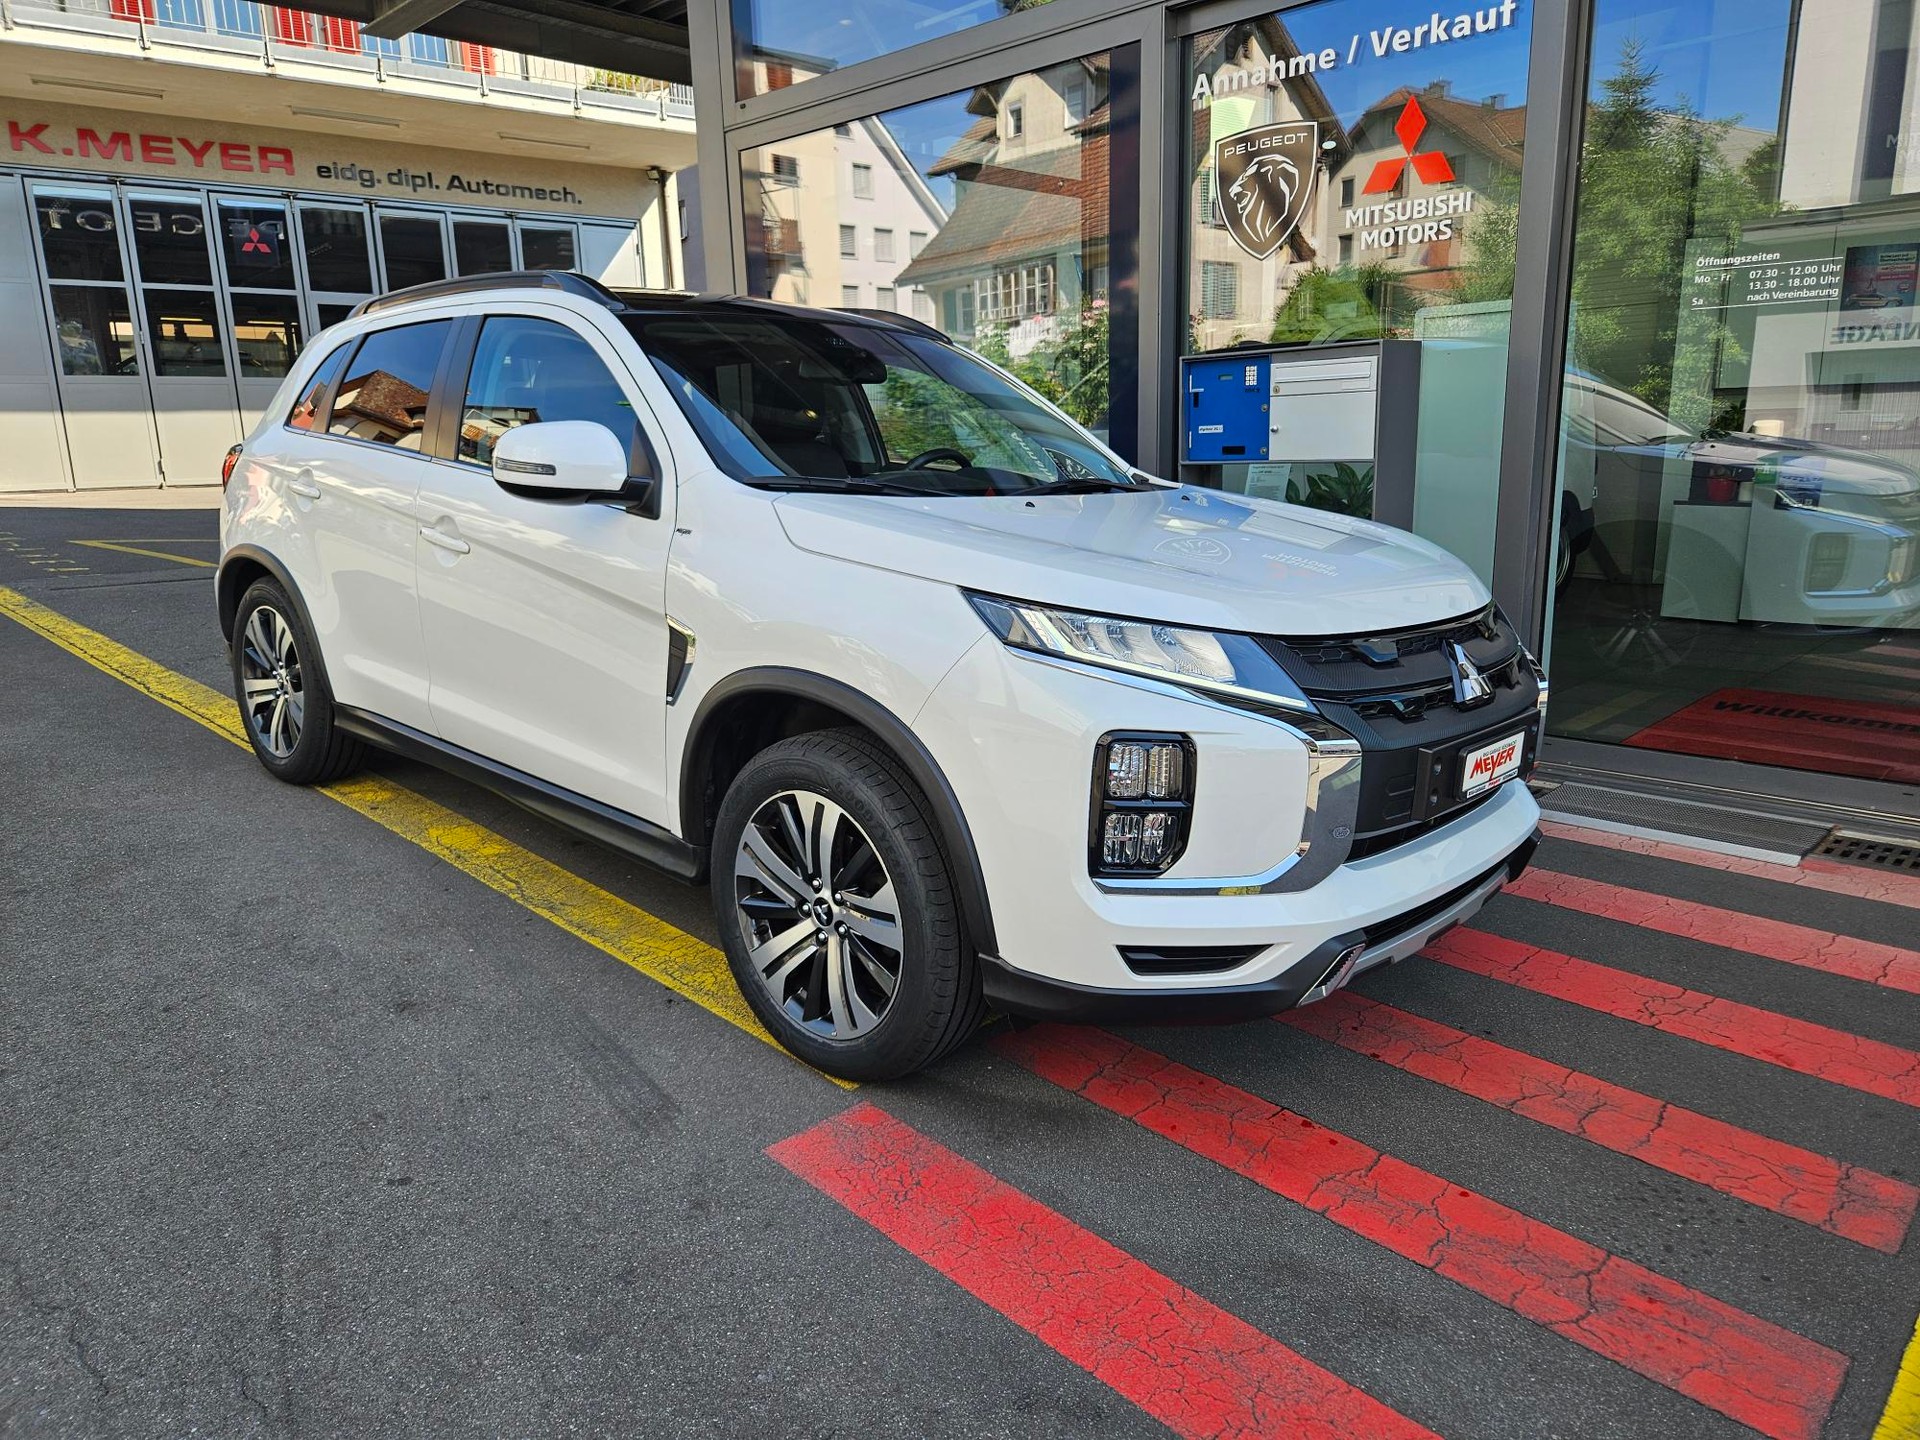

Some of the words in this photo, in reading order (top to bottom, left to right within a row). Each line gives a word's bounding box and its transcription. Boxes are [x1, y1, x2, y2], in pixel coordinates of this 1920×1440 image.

[1192, 47, 1336, 99] Annahme
[1346, 34, 1359, 64] /
[1370, 0, 1516, 57] Verkauf
[8, 120, 295, 176] K.MEYER
[1224, 133, 1308, 159] PEUGEOT
[317, 162, 382, 188] eidg.
[387, 168, 440, 193] dipl.
[446, 174, 583, 205] Automech.
[1345, 191, 1474, 229] MITSUBISHI
[1361, 219, 1453, 250] MOTORS
[1694, 276, 1711, 284] Mo
[1721, 273, 1732, 282] Fr
[1749, 268, 1778, 279] 07.30
[1789, 265, 1818, 276] 12.00
[1821, 263, 1842, 273] Uhr
[1695, 252, 1780, 268] Öffnungszeiten
[1691, 297, 1704, 306] Sa
[1747, 291, 1770, 301] nach
[1772, 287, 1840, 300] Vereinbarung
[1749, 280, 1777, 290] 13.30
[1788, 277, 1817, 287] 18.00
[1820, 275, 1841, 284] Uhr
[1469, 745, 1516, 781] MEYER
